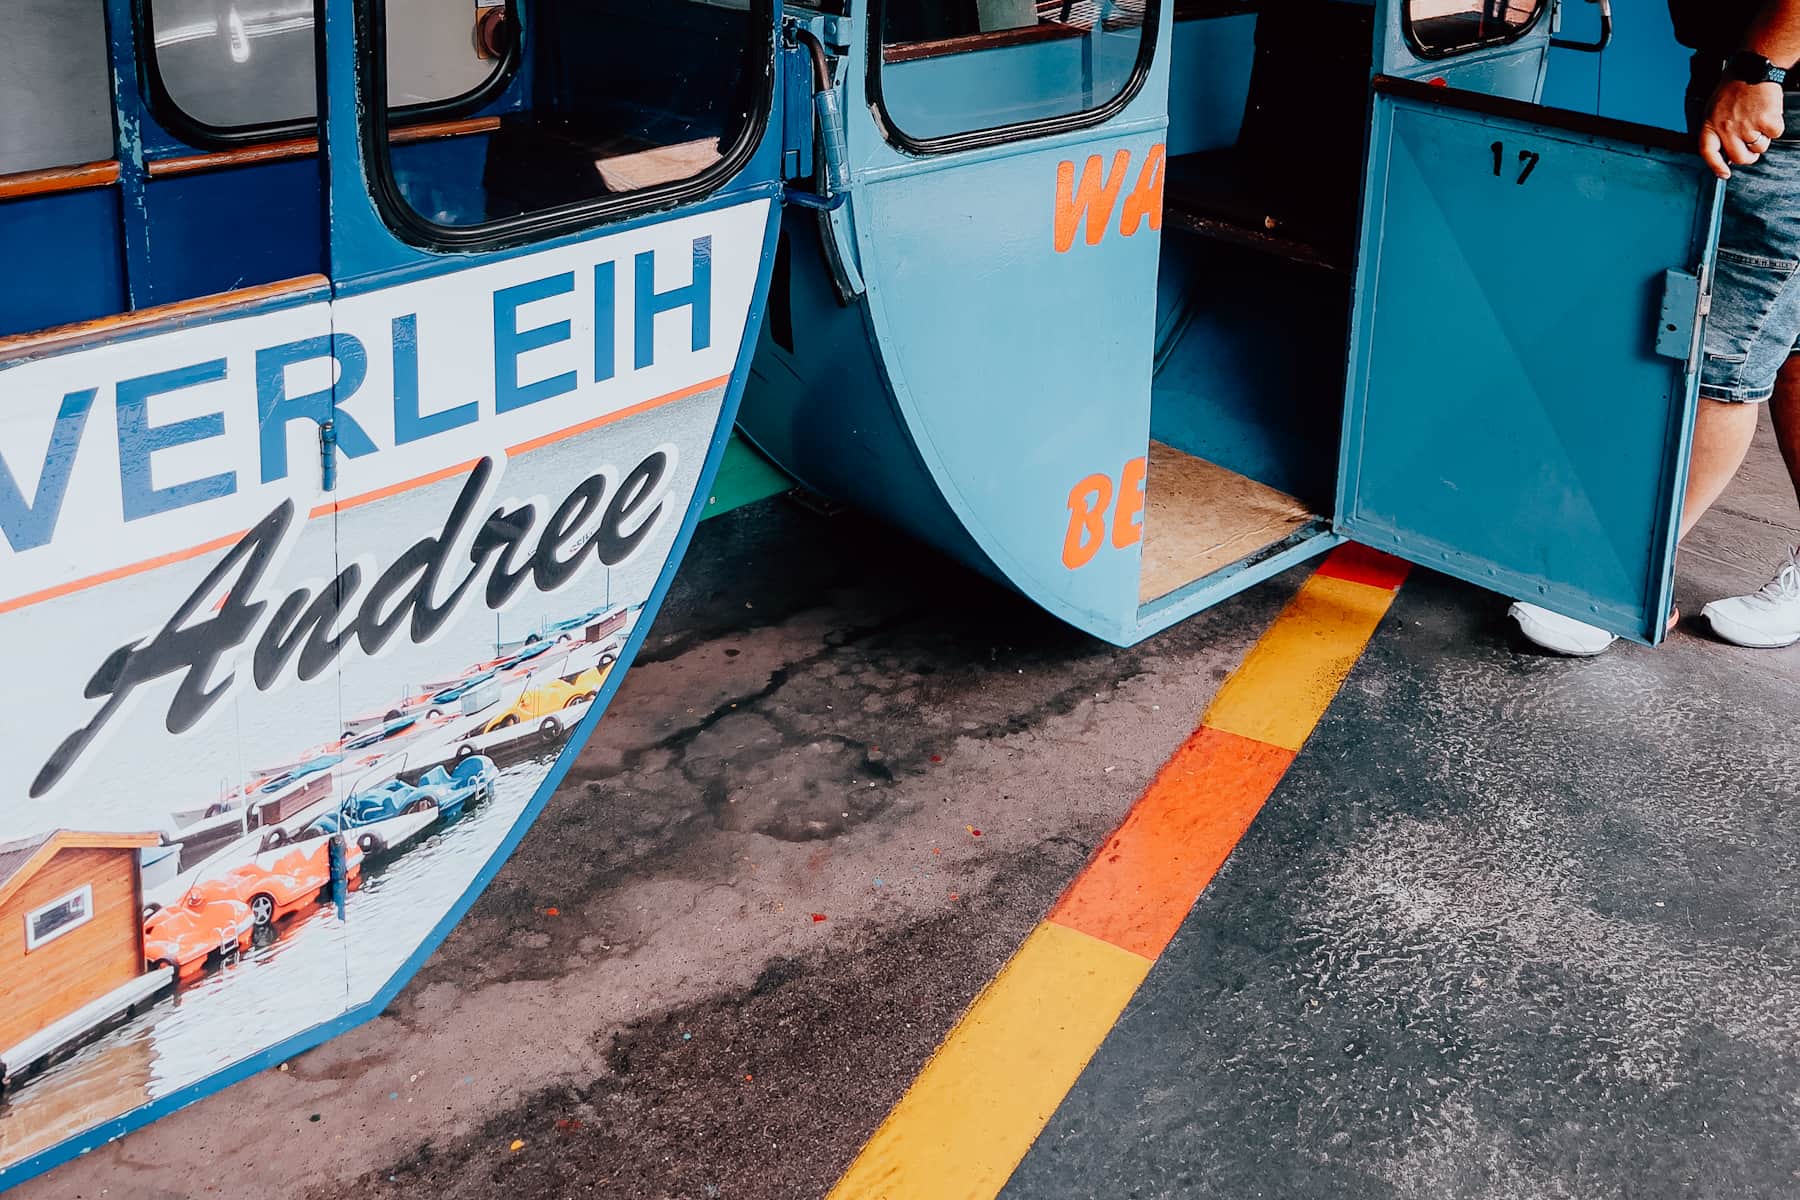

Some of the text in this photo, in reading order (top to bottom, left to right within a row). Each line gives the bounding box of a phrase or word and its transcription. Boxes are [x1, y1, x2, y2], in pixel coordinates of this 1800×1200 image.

[1054, 143, 1165, 253] WA
[0, 234, 712, 553] VERLEIH
[1062, 456, 1146, 570] BE
[29, 450, 668, 799] Andree
